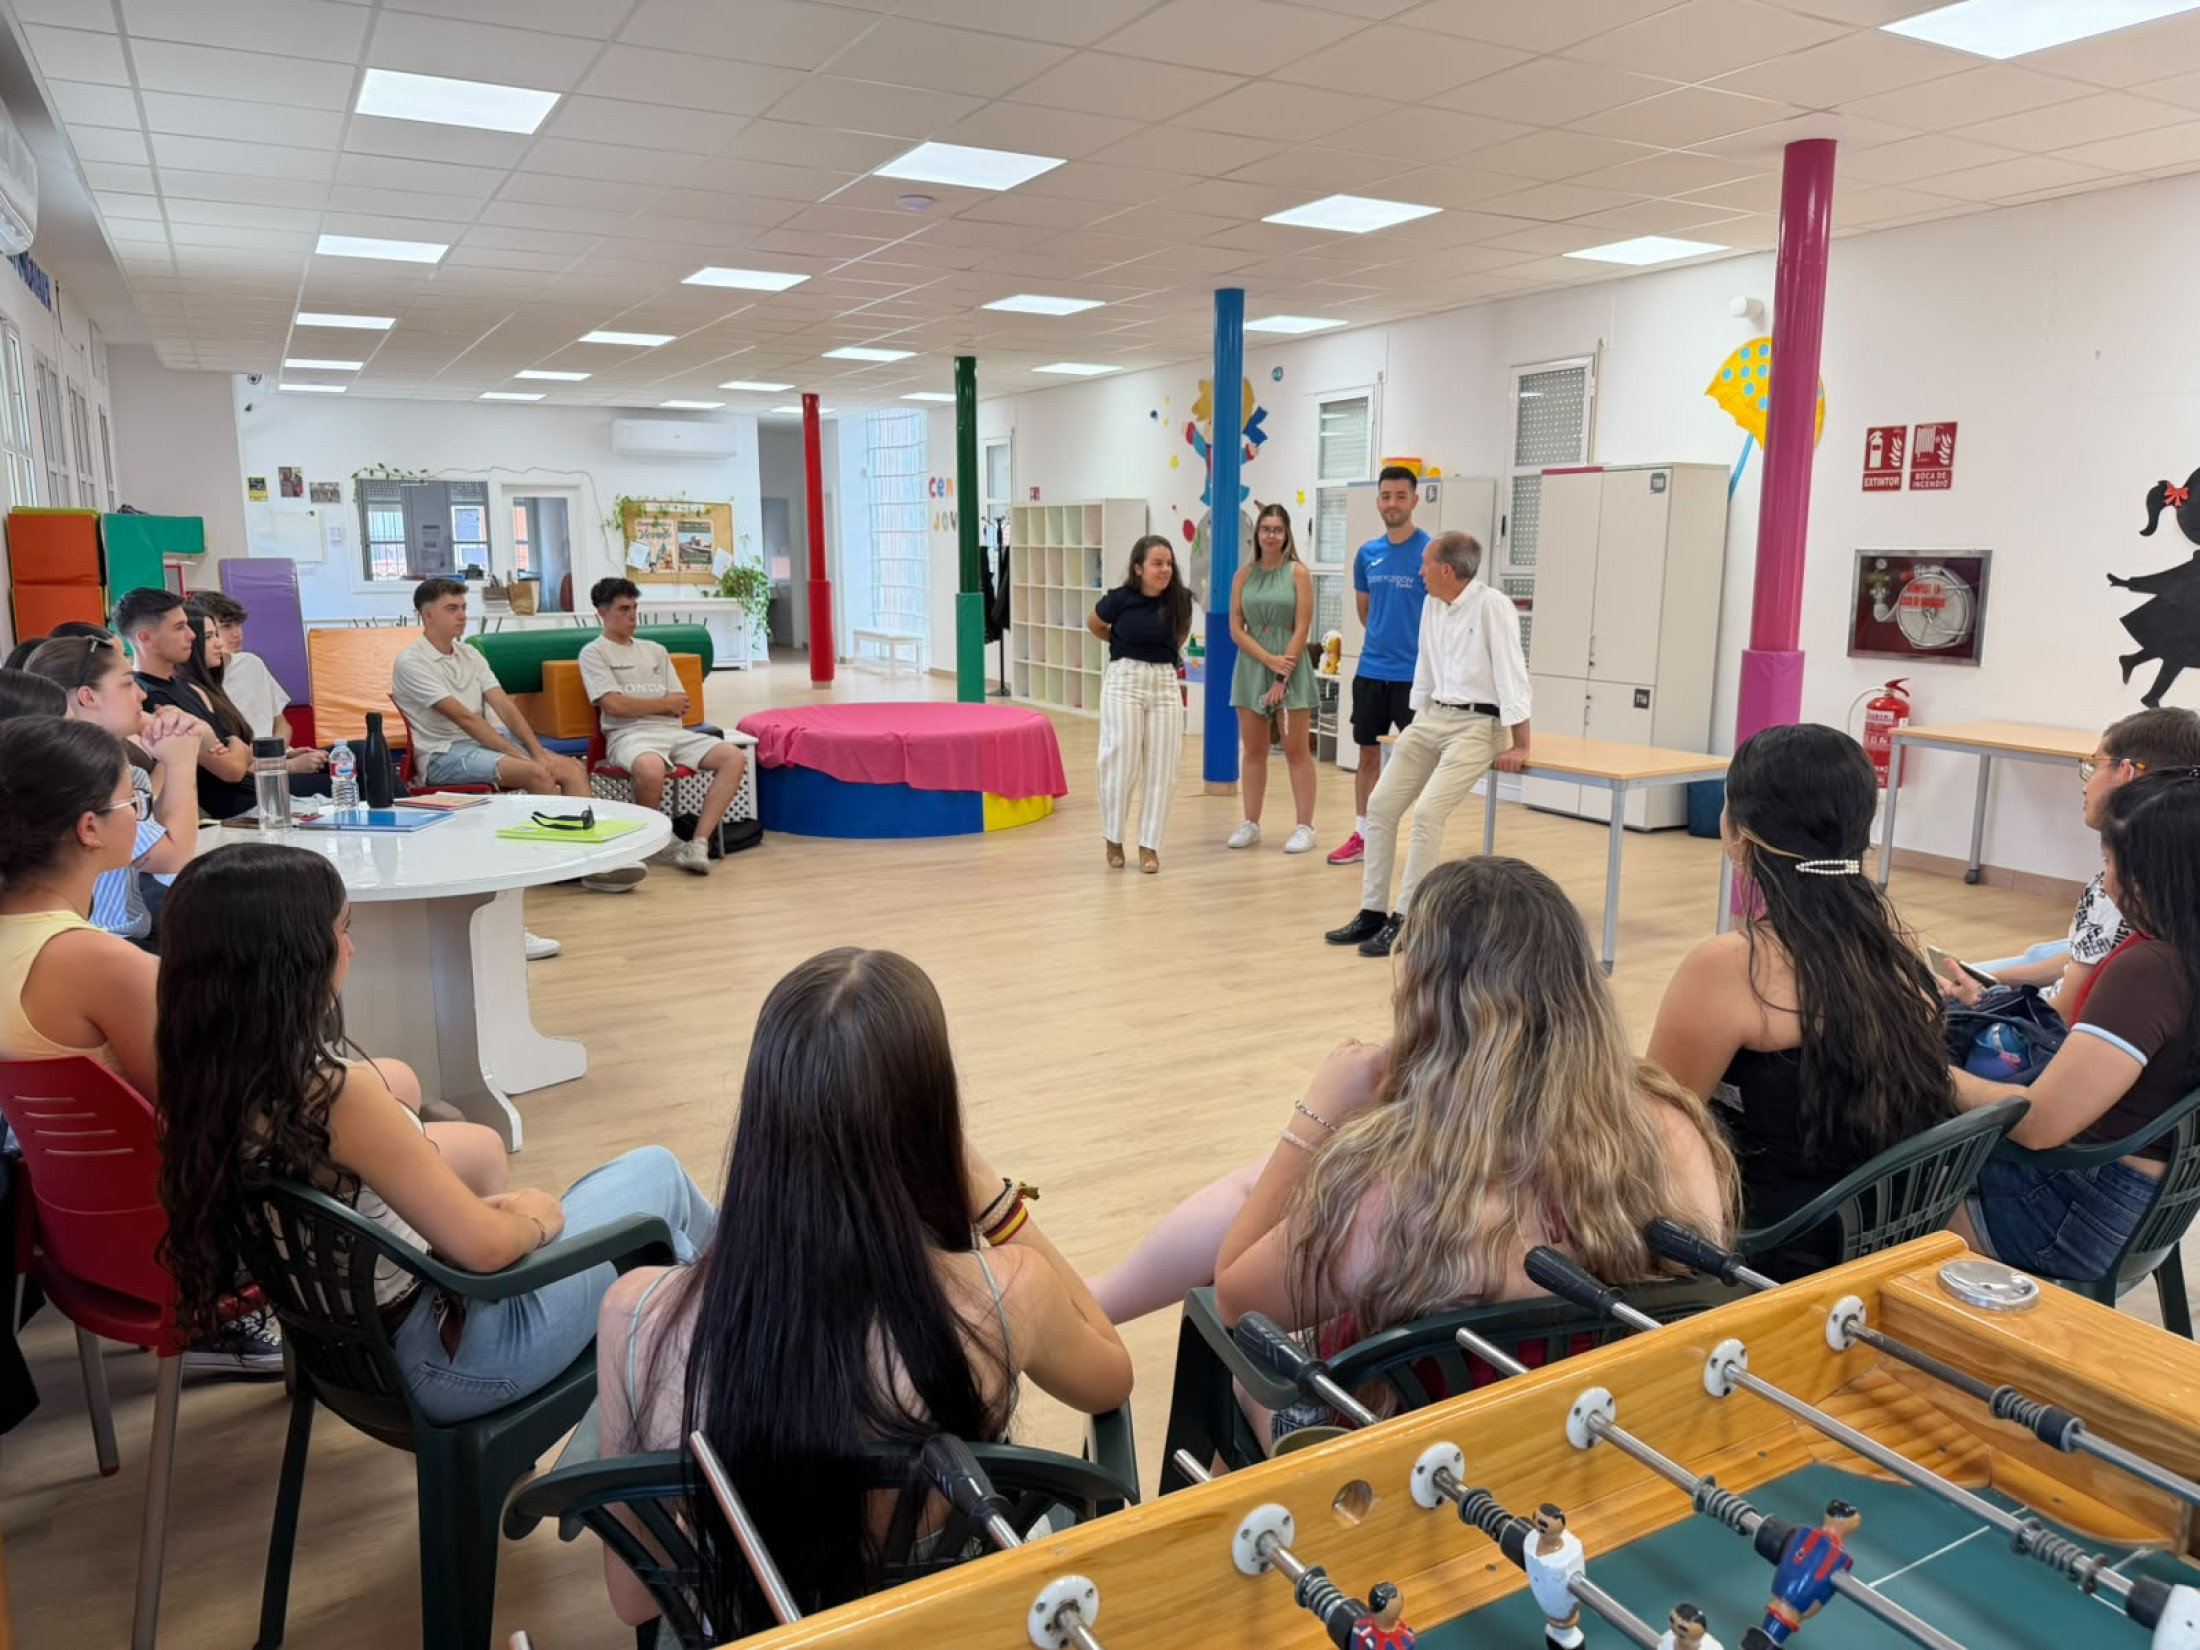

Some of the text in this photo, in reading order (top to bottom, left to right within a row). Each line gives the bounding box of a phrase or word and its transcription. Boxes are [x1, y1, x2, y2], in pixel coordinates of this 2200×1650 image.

[1914, 471, 1947, 480] BOCA DE
[1863, 476, 1900, 488] EXTINTOR
[1912, 480, 1949, 489] INCENDIO
